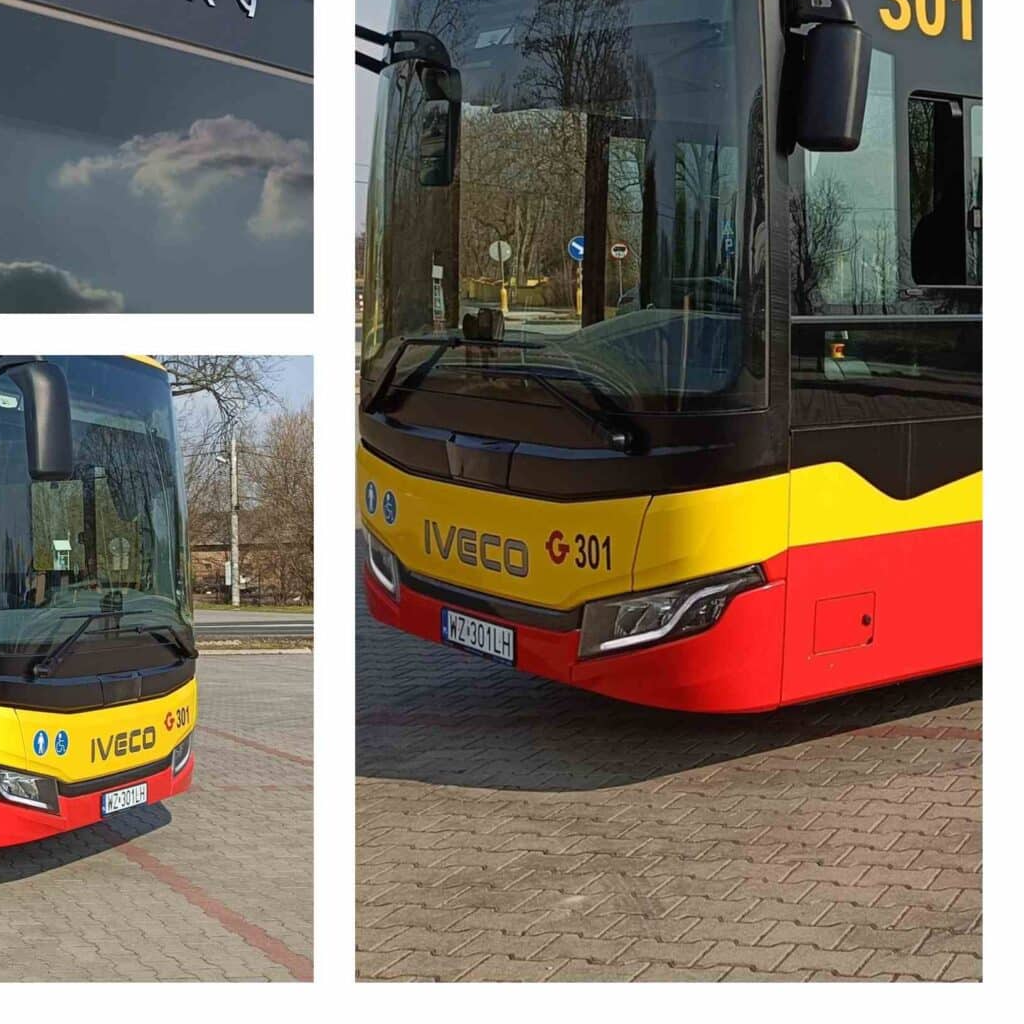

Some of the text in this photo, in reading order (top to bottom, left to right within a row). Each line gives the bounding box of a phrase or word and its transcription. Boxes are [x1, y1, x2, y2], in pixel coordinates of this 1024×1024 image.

[424, 519, 529, 578] IVECO
[575, 533, 611, 571] 301
[470, 621, 511, 657] 301LH
[176, 706, 189, 727] 301
[91, 726, 155, 763] IVECO
